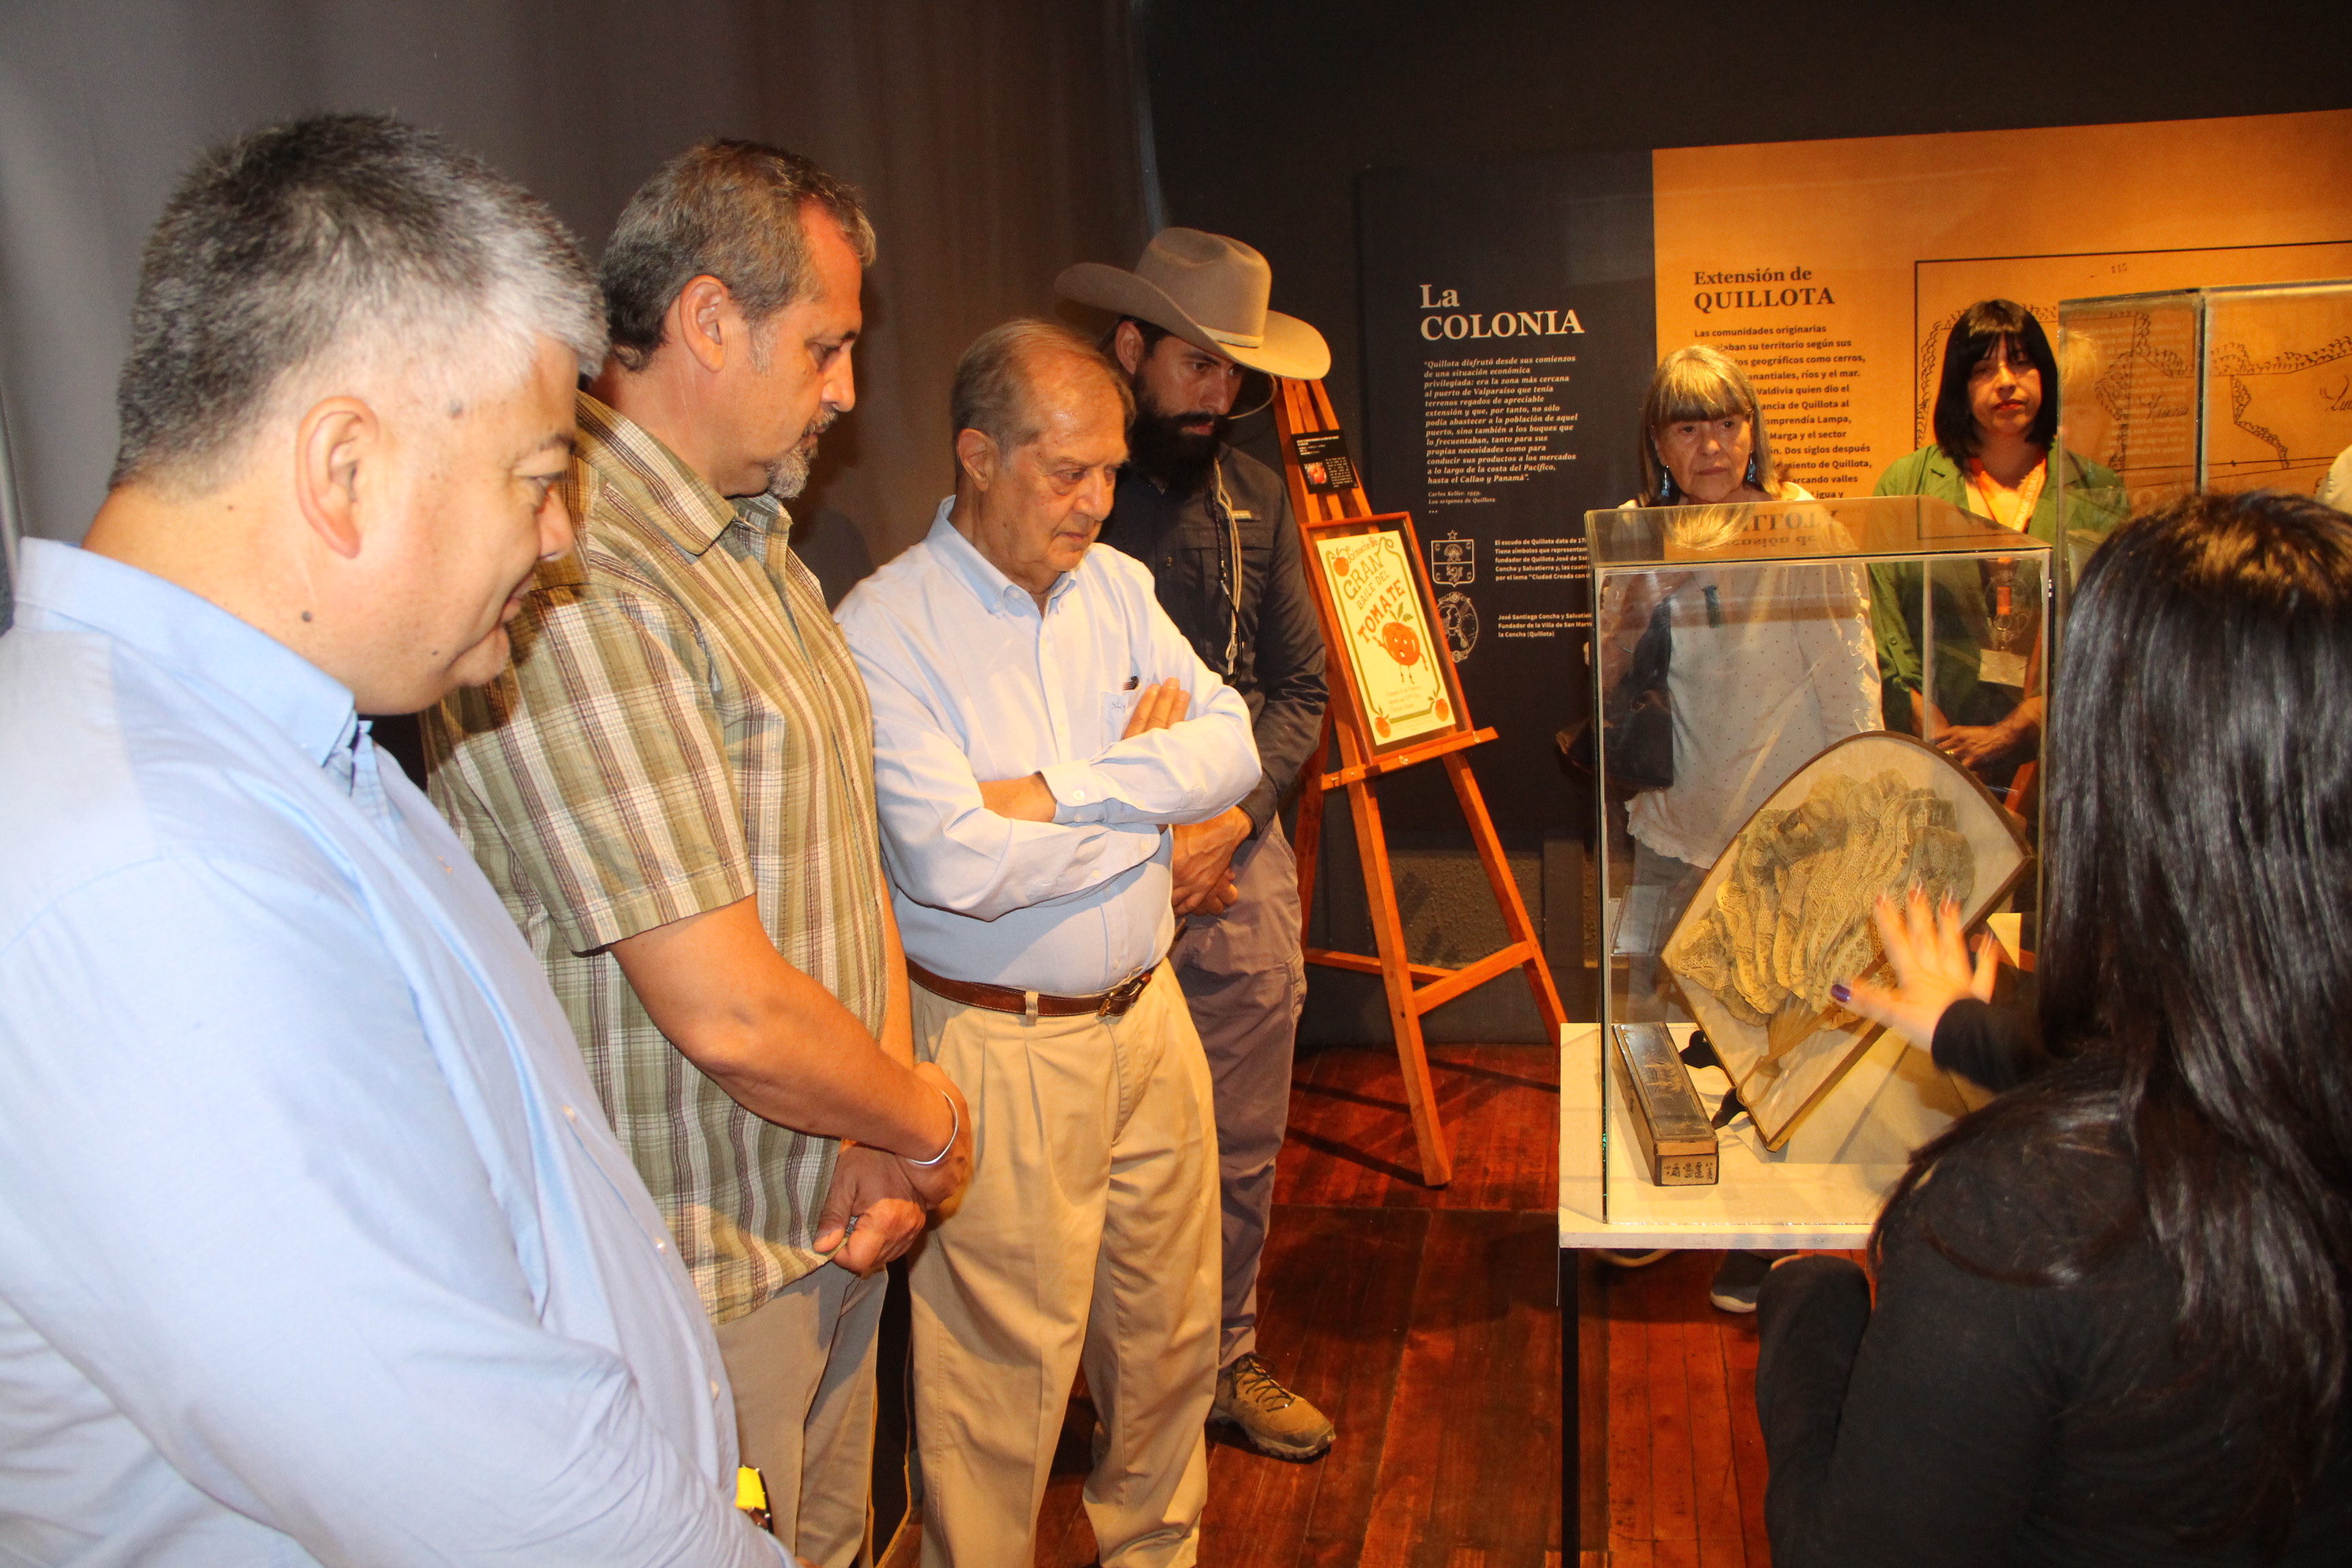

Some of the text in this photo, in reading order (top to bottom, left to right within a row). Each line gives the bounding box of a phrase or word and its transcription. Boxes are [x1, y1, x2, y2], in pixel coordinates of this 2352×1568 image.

[1695, 266, 1812, 284] Extensión de
[1420, 284, 1460, 308] La
[1695, 287, 1835, 314] QUILLOTA
[1420, 309, 1585, 341] COLONIA
[1712, 327, 1774, 337] comunidades
[1776, 325, 1827, 335] originarias
[1761, 341, 1804, 350] territorio
[1807, 339, 1834, 349] según
[1461, 358, 1494, 368] disfrutó
[1496, 357, 1518, 365] desde
[1535, 355, 1576, 363] comienzos
[1751, 356, 1804, 368] geográficos
[1452, 368, 1488, 376] situación
[1490, 366, 1531, 375] económica
[1748, 372, 1799, 382] anantiales,
[1801, 370, 1819, 378] ríos
[1424, 379, 1474, 389] privilegiada:
[1434, 390, 1460, 399] puerto
[1474, 387, 1516, 396] Valparaíso
[1757, 387, 1793, 395] Valdivia
[1796, 386, 1822, 395] quien
[1460, 397, 1490, 407] regados
[1504, 395, 1544, 405] apreciable
[1801, 400, 1838, 410] Quillota
[1425, 408, 1463, 416] extensión
[1490, 408, 1505, 416] por
[1425, 419, 1448, 428] podía
[1505, 414, 1543, 425] población
[1556, 413, 1578, 423] aquel
[1766, 415, 1815, 426] omprendía
[1426, 429, 1454, 438] puerto,
[1475, 426, 1507, 434] también
[1529, 425, 1557, 433] buques
[1769, 433, 1797, 441] Marga
[1435, 436, 1489, 446] frecuentaban,
[1426, 448, 1456, 457] propias
[1458, 446, 1504, 454] necesidades
[1528, 445, 1546, 453] para
[1804, 446, 1830, 455] siglos
[1832, 444, 1870, 454] después
[1427, 457, 1460, 465] conducir
[1477, 455, 1517, 465] productos
[1539, 453, 1577, 461] mercados
[1832, 460, 1872, 470] Quillota,
[1444, 467, 1465, 475] largo
[1524, 463, 1556, 472] Pacífico,
[1460, 475, 1485, 483] Callao
[1343, 553, 1384, 600] GRAN
[1356, 570, 1390, 610] BAILE DEL
[1357, 578, 1406, 644] TOMATE
